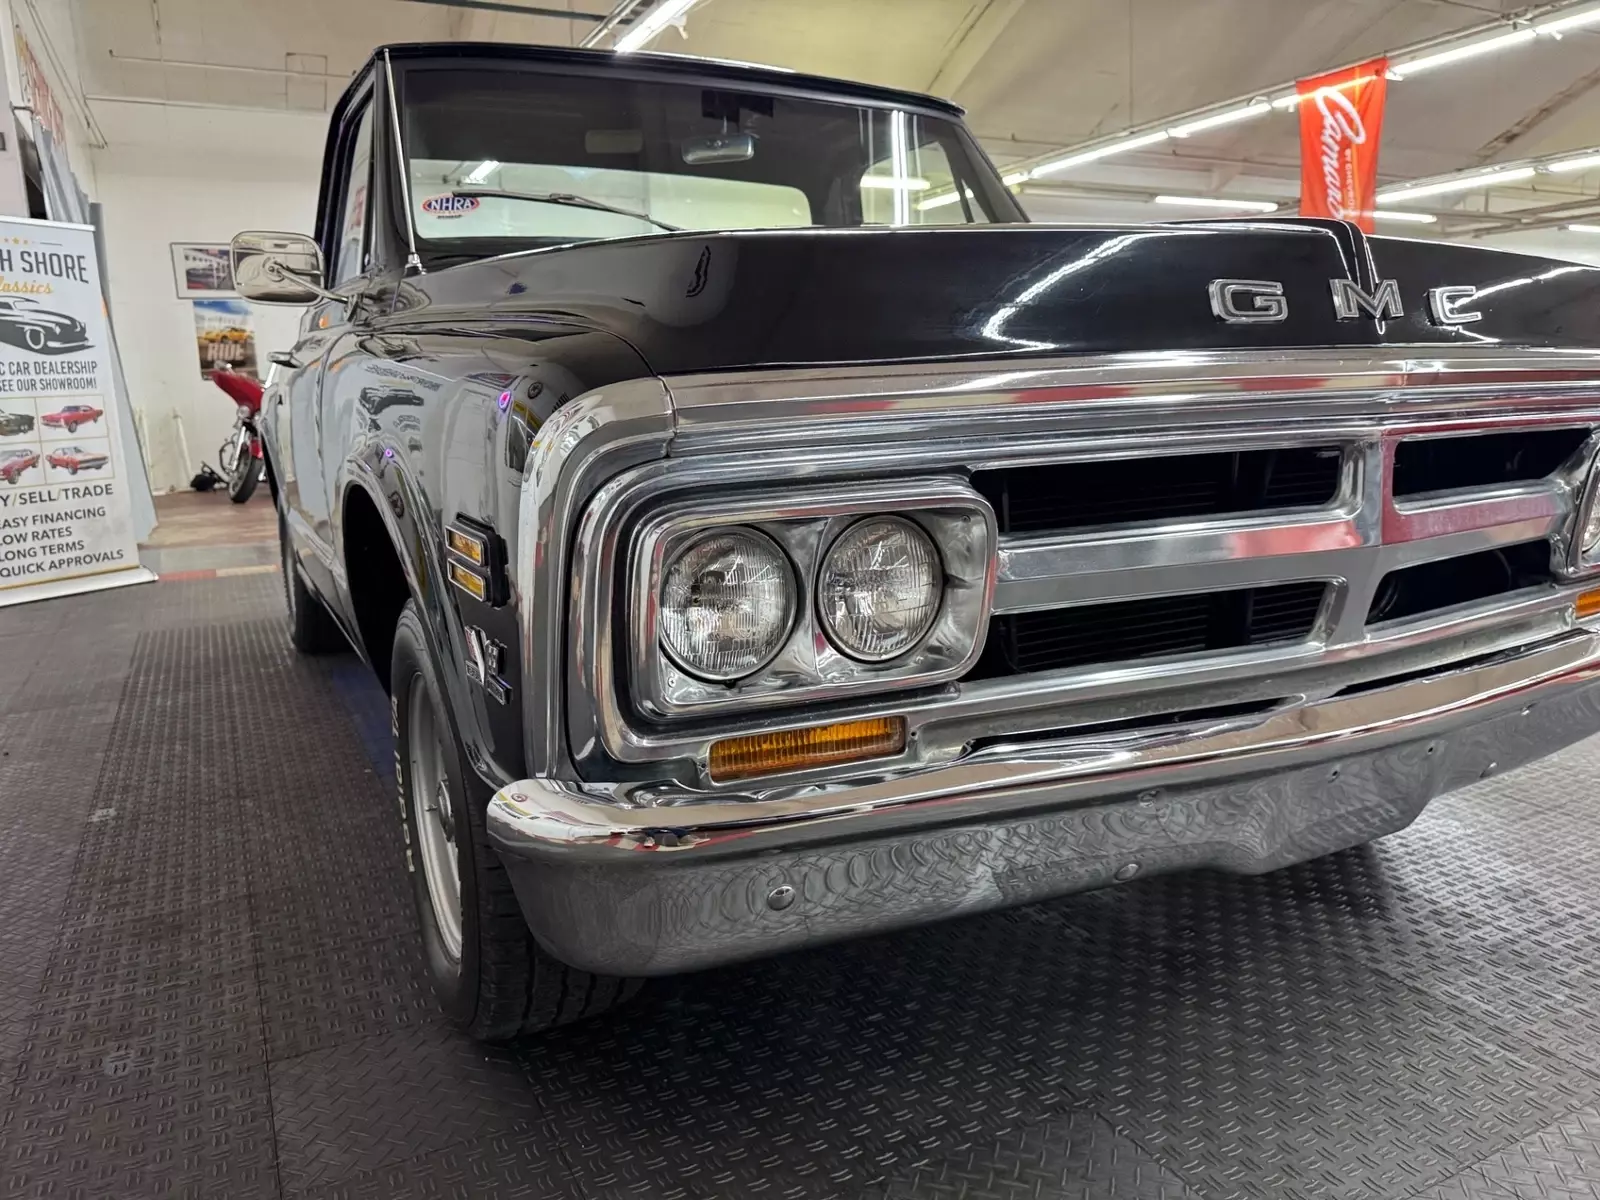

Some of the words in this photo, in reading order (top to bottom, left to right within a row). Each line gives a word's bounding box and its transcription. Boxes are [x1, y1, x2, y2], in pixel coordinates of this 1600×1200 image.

[1315, 86, 1366, 220] Camaro
[431, 196, 472, 210] NHRA
[20, 250, 89, 284] SHORE
[1207, 278, 1483, 325] GMC
[9, 361, 30, 376] CAR
[34, 361, 97, 375] DEALERSHIP
[16, 378, 37, 391] OUR
[39, 377, 97, 391] SHOWROOM!
[0, 515, 28, 530] ASY
[32, 506, 106, 525] FINANCING
[32, 526, 72, 541] RATES
[40, 540, 85, 556] TERMS
[0, 562, 45, 578] QUICK
[48, 549, 124, 570] APPROVALS
